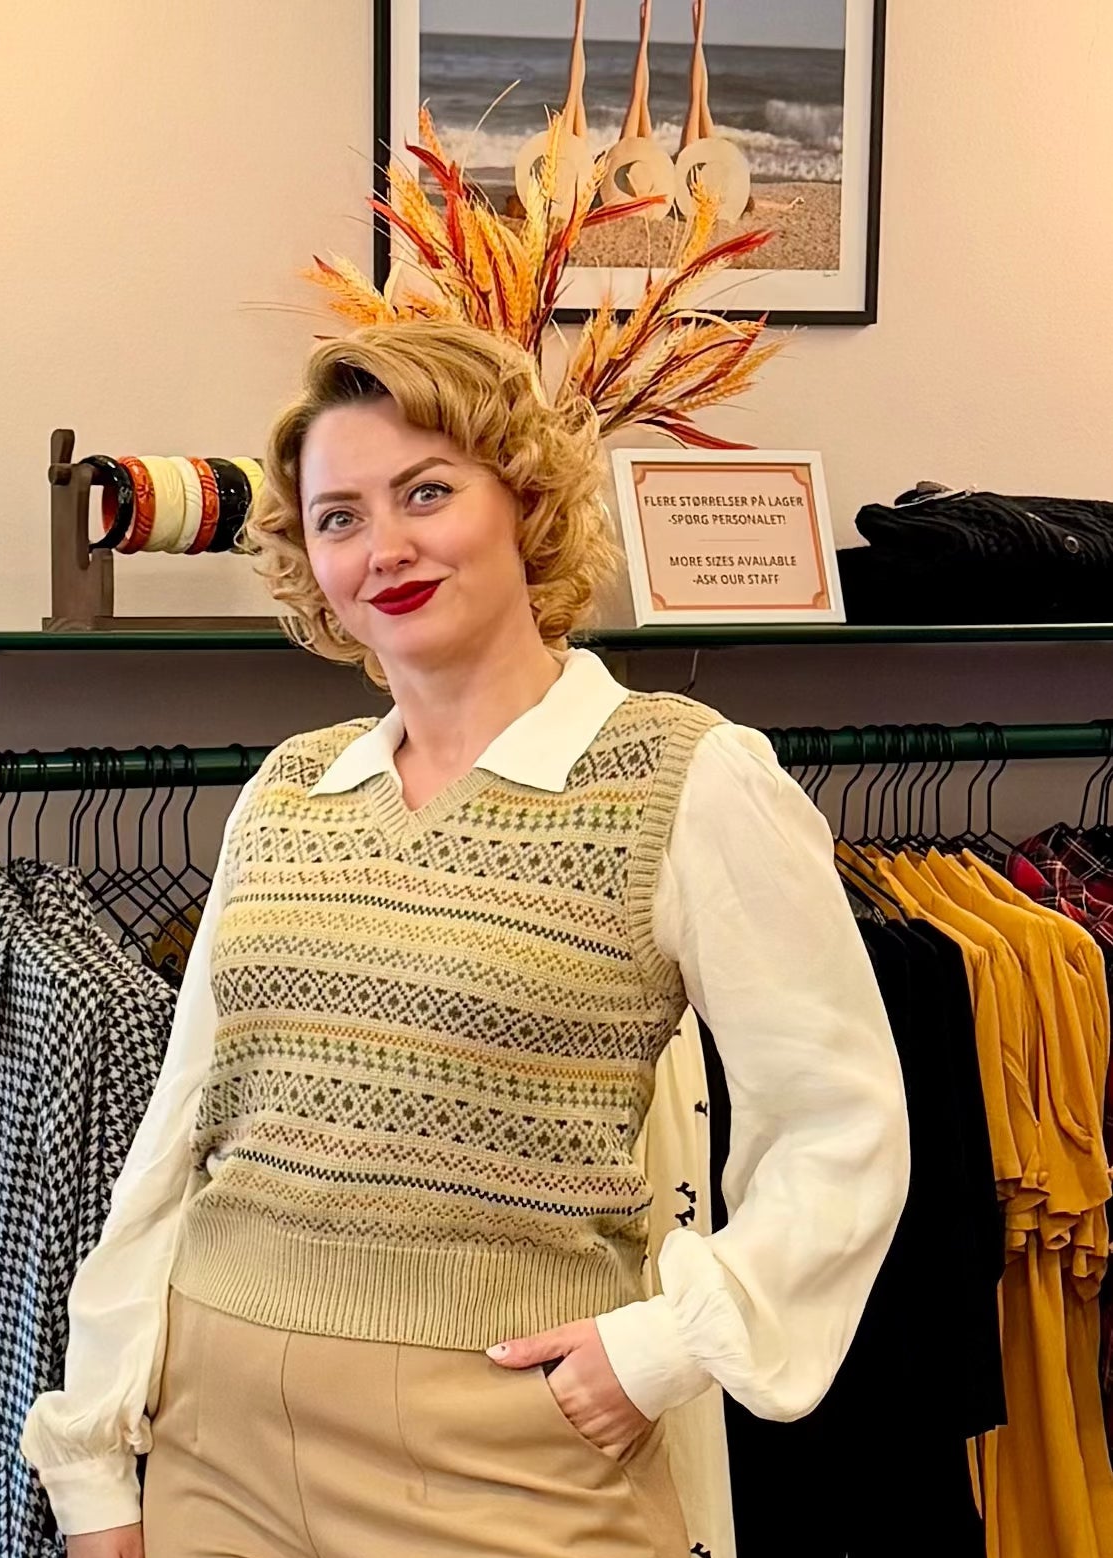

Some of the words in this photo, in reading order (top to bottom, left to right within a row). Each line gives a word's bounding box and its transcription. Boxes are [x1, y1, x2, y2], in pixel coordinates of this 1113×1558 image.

[643, 496, 677, 507] FLERE
[679, 495, 748, 507] STØRRELSER
[751, 493, 766, 507] PÅ
[768, 496, 804, 507] LAGER
[669, 556, 703, 567] MORE
[705, 556, 734, 567] SIZES
[737, 555, 797, 567] AVAILABLE
[720, 574, 745, 585] OUR
[747, 574, 780, 585] STAFF
